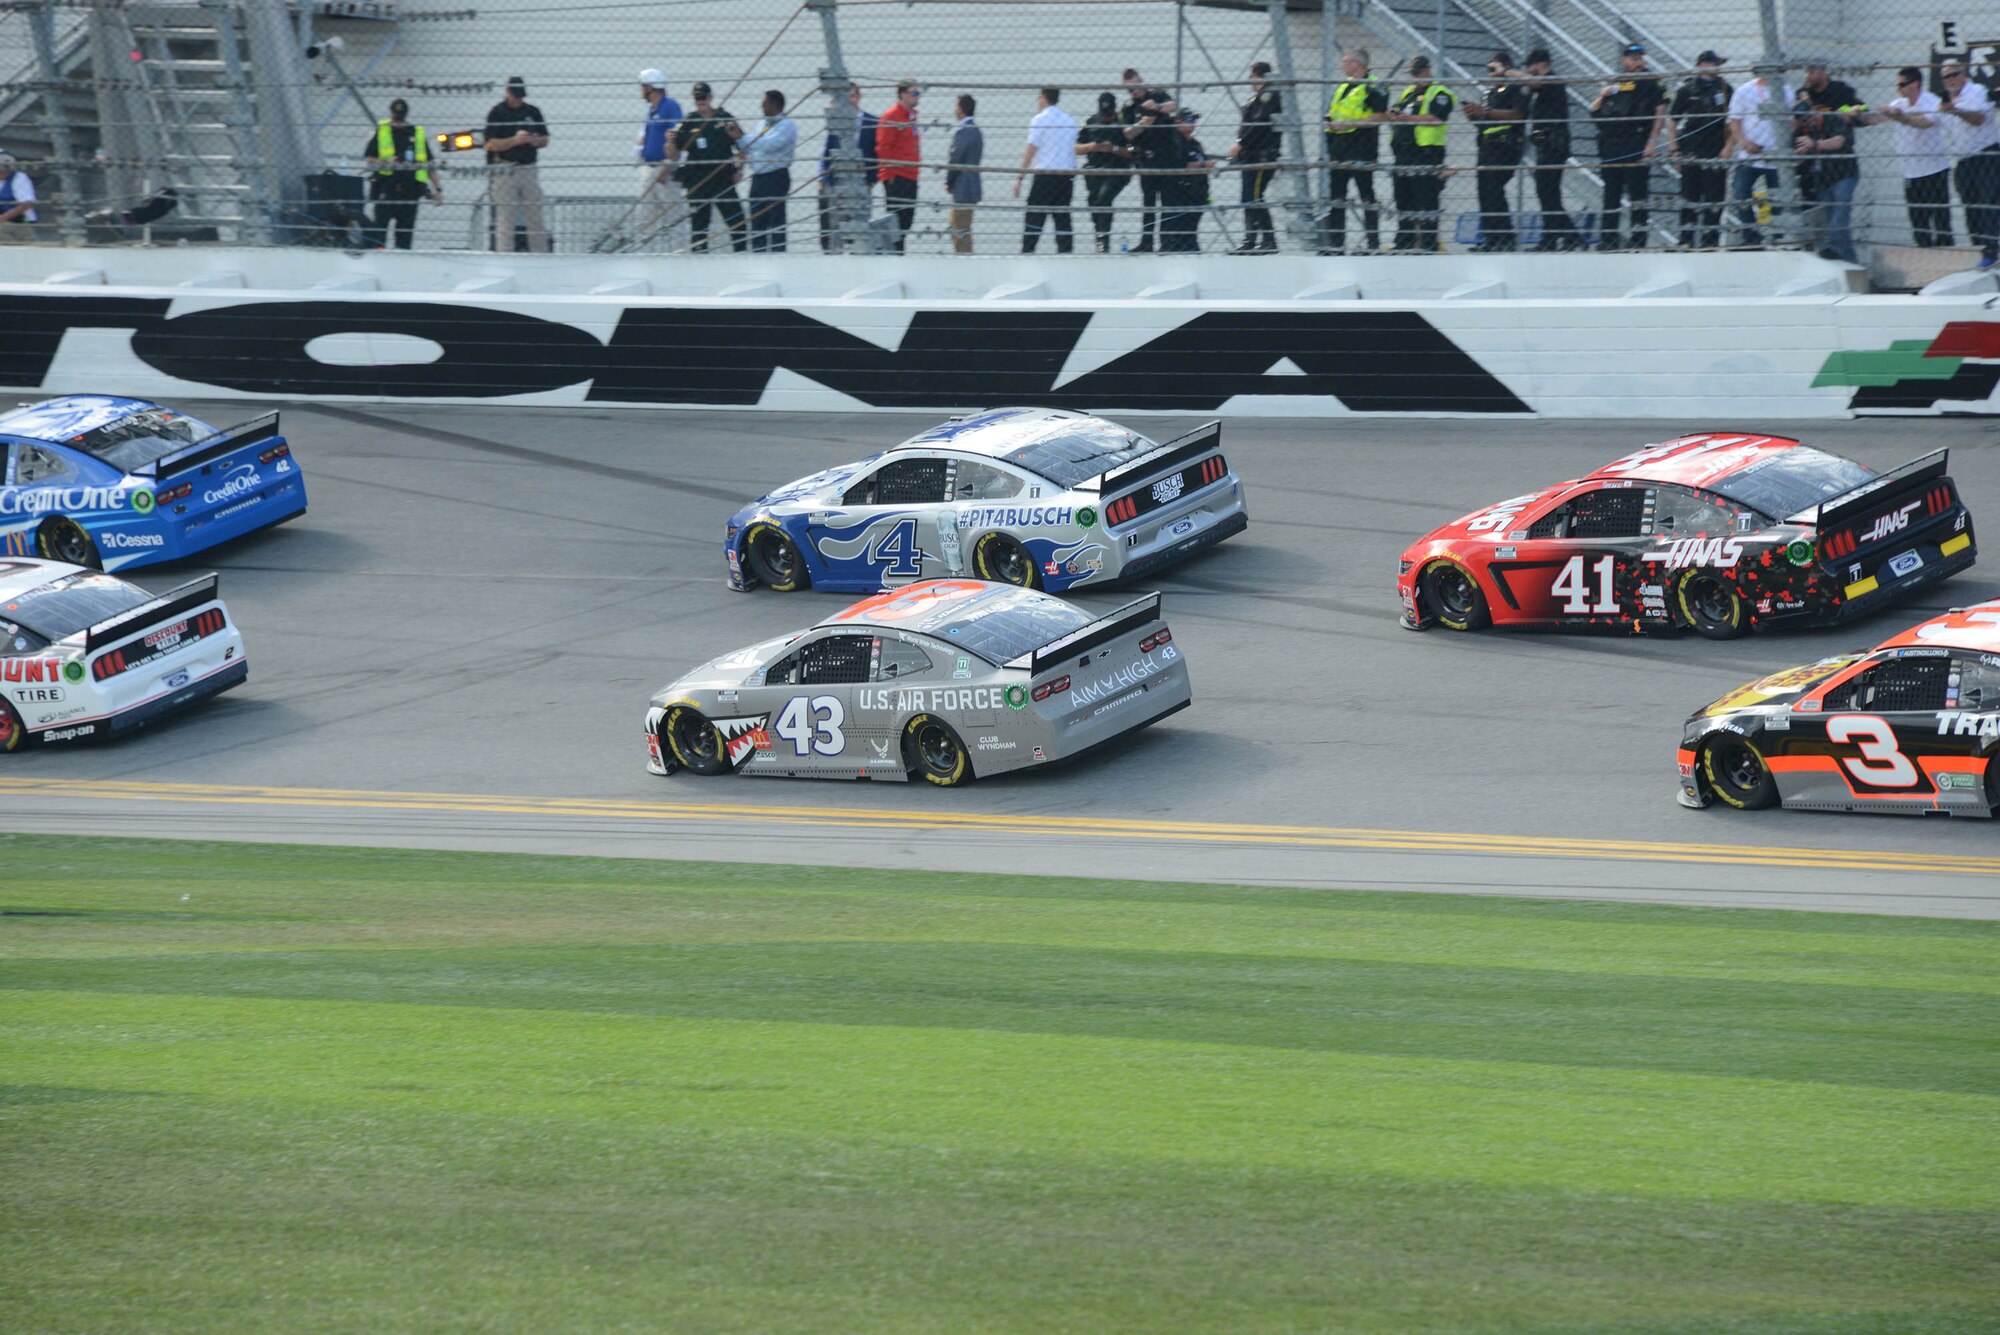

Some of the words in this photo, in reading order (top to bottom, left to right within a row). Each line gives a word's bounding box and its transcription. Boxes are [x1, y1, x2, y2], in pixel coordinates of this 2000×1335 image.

[1942, 22, 1956, 47] E
[275, 459, 291, 473] 42
[203, 473, 261, 503] CreditOne
[1152, 473, 1184, 499] BUSCH
[960, 507, 1072, 528] #PIT4BUSCH
[1859, 499, 1921, 542] HAAS
[1953, 511, 1966, 531] 41
[116, 533, 164, 547] Cessna
[875, 519, 923, 577] 4
[1641, 535, 1783, 569] HAAS
[1550, 555, 1621, 613] 41
[145, 620, 188, 646] DISCOUNT
[225, 645, 235, 660] 2
[1161, 645, 1177, 660] 43
[0, 657, 60, 683] UNT
[1070, 680, 1106, 708] AIM
[1114, 653, 1160, 687] HIGH
[17, 689, 59, 701] TIRE
[859, 689, 893, 710] U.S.
[897, 690, 925, 711] AIR
[931, 687, 1003, 711] FORCE
[1094, 689, 1143, 716] CAMARO
[43, 725, 95, 742] Snap-on
[773, 696, 847, 757] 43
[1935, 711, 2000, 736] TRA
[977, 742, 1016, 751] WYNDHAM
[1826, 713, 1919, 788] 3
